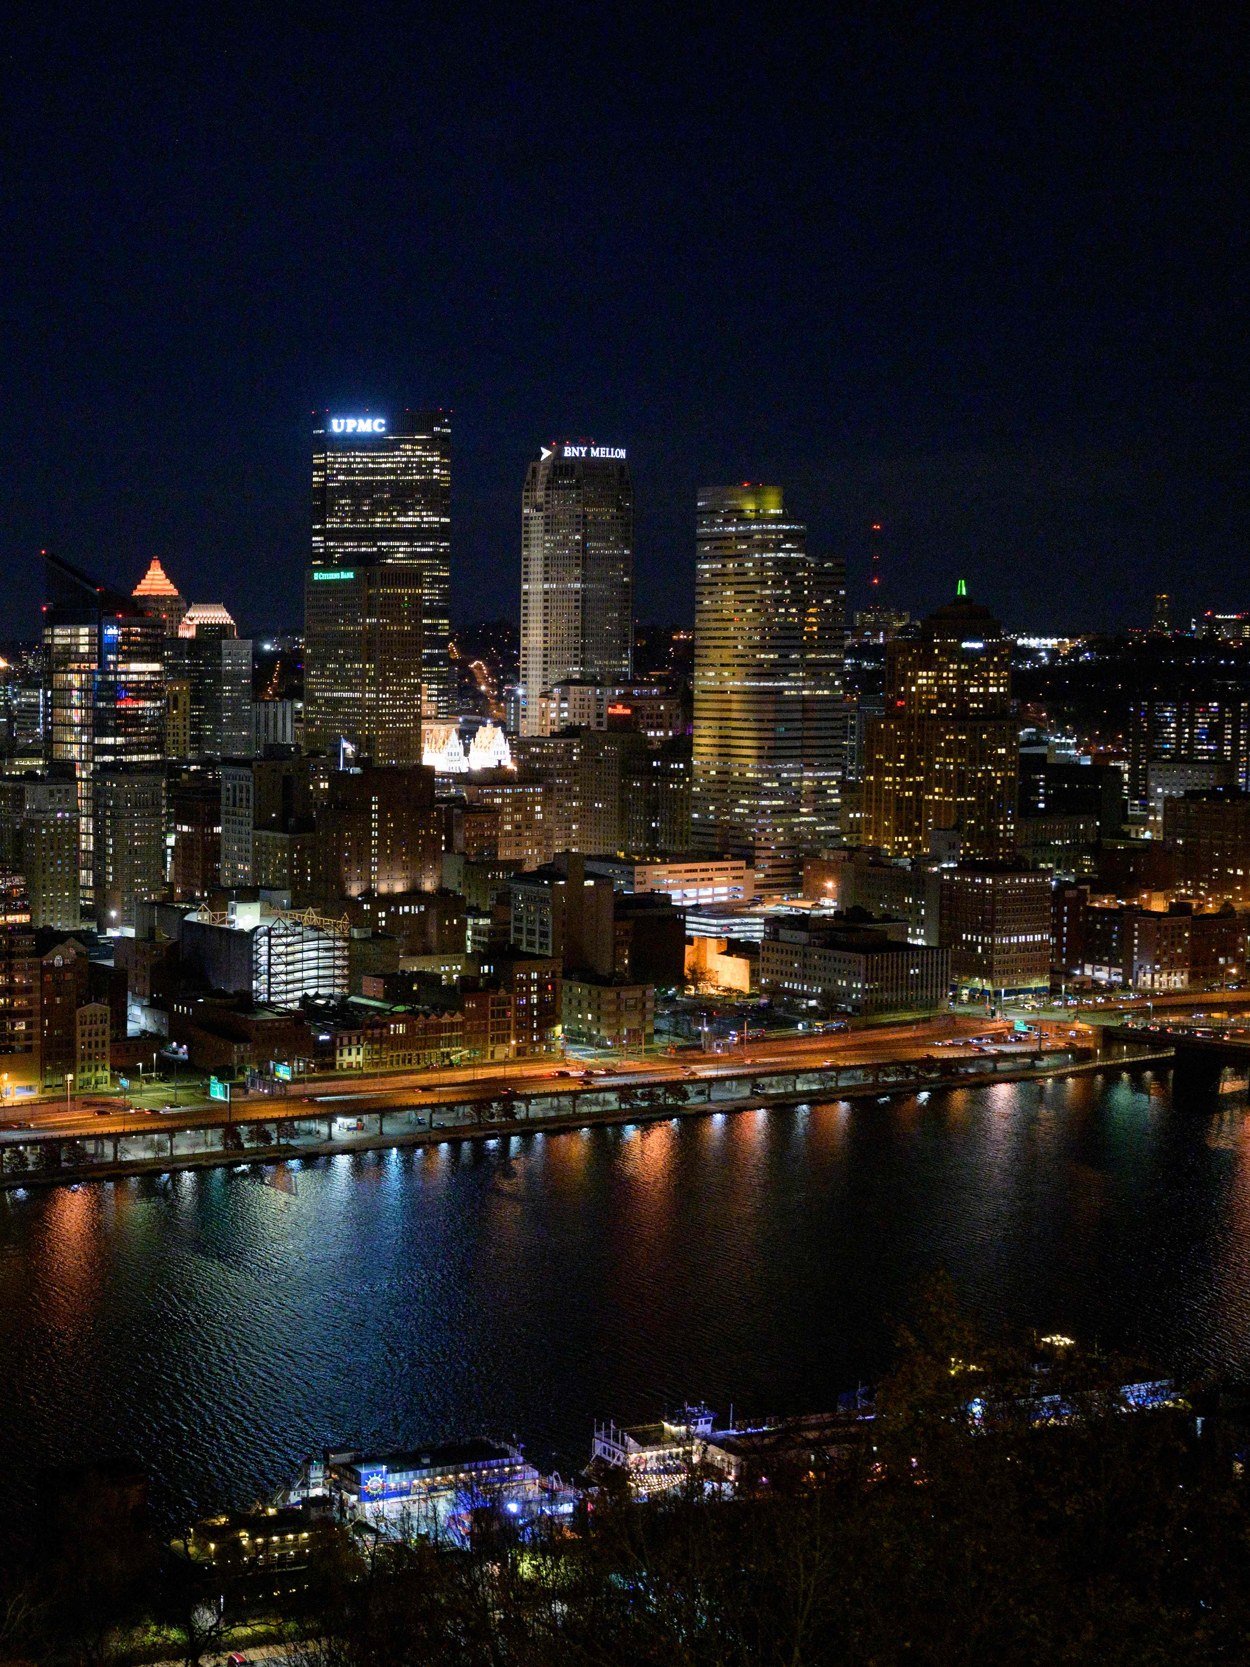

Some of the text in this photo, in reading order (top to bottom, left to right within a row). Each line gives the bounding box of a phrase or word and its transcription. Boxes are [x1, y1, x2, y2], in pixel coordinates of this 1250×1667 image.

[332, 419, 385, 433] UPMC
[564, 446, 626, 460] BNY MELLON
